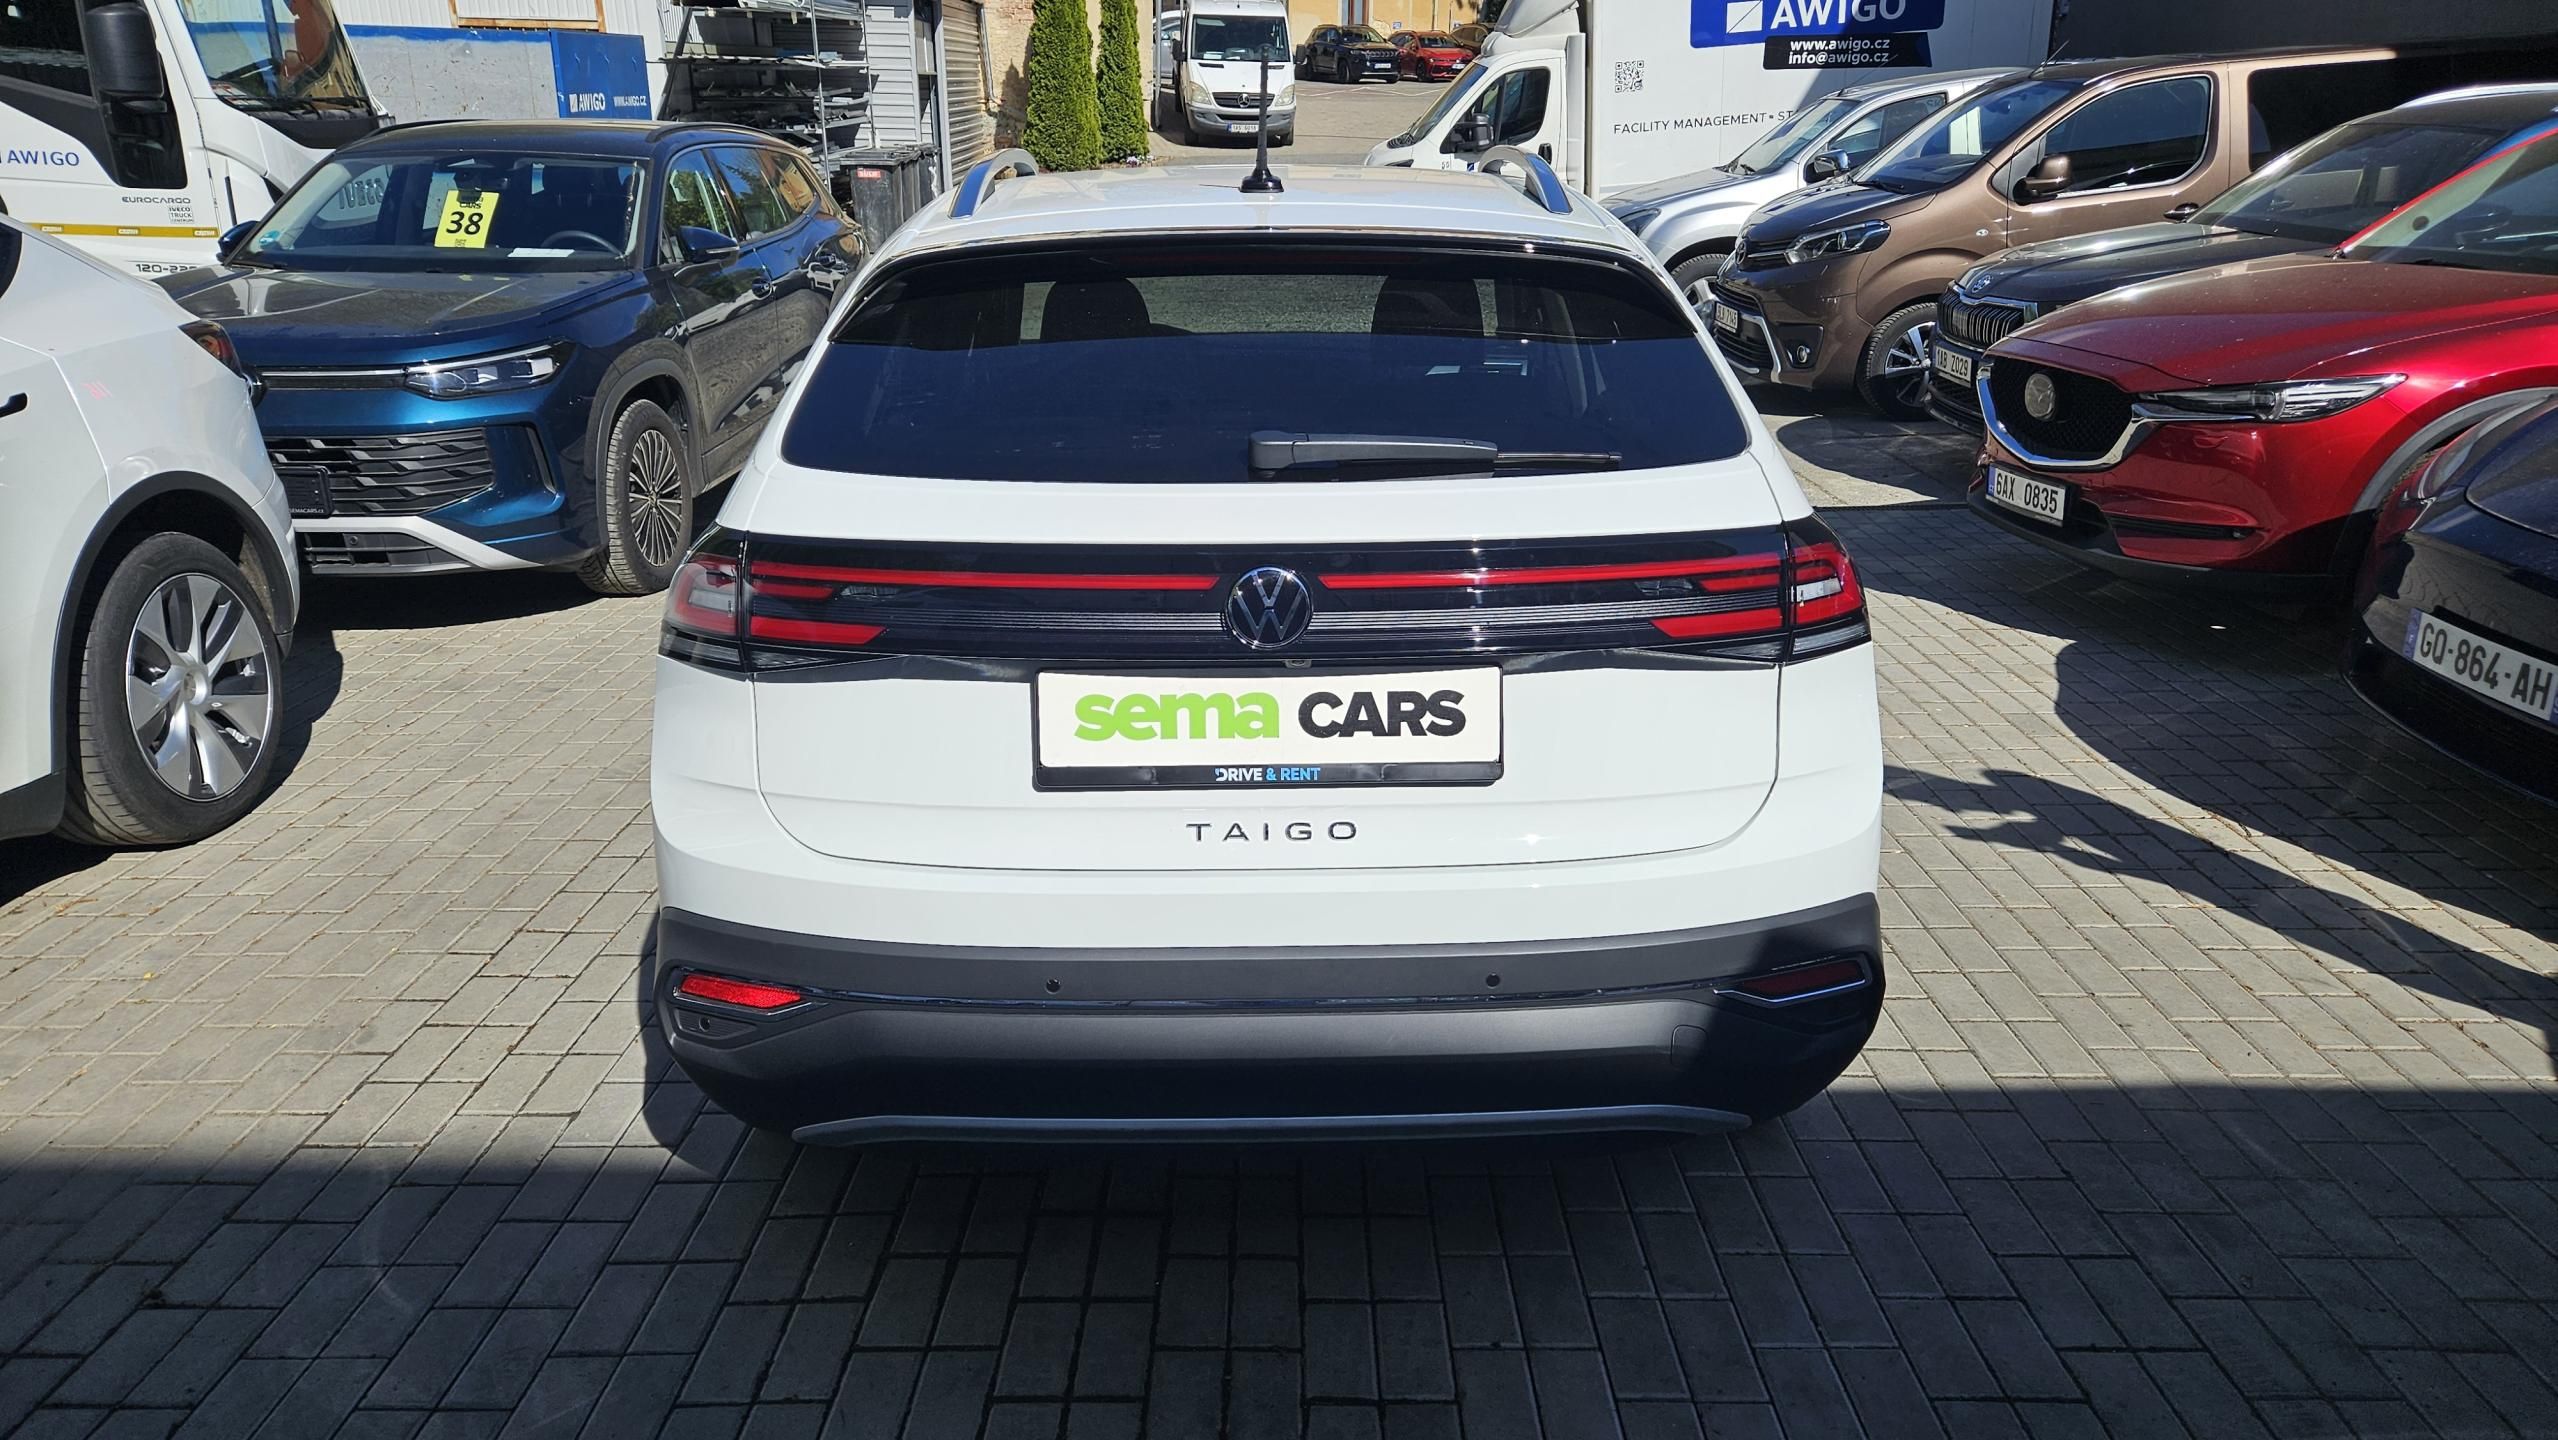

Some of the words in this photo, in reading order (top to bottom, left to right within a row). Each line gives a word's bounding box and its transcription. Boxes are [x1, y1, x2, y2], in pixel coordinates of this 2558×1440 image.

[1770, 0, 1906, 30] AWIGO
[1790, 38, 1890, 51] www.awigo.cz
[1788, 51, 1889, 65] info@awigo.cz
[579, 92, 606, 112] AWIGO
[1614, 119, 1670, 135] FACILITY
[1674, 112, 1767, 130] MANAGEMENT
[7, 149, 80, 167] AWIGO
[122, 196, 191, 204] EUROCARGO
[446, 211, 484, 235] 38
[136, 264, 198, 274] 120-22
[1950, 355, 1969, 377] Z029
[1996, 472, 2016, 501] 6AX
[2024, 482, 2059, 514] 0835
[2420, 622, 2553, 710] GQ-864-AH
[1074, 692, 1280, 741] sema
[1298, 690, 1467, 738] CARS
[1215, 767, 1263, 781] DRIVE
[1266, 767, 1277, 781] &
[1280, 767, 1321, 780] RENT
[1186, 820, 1358, 842] TAIGO
